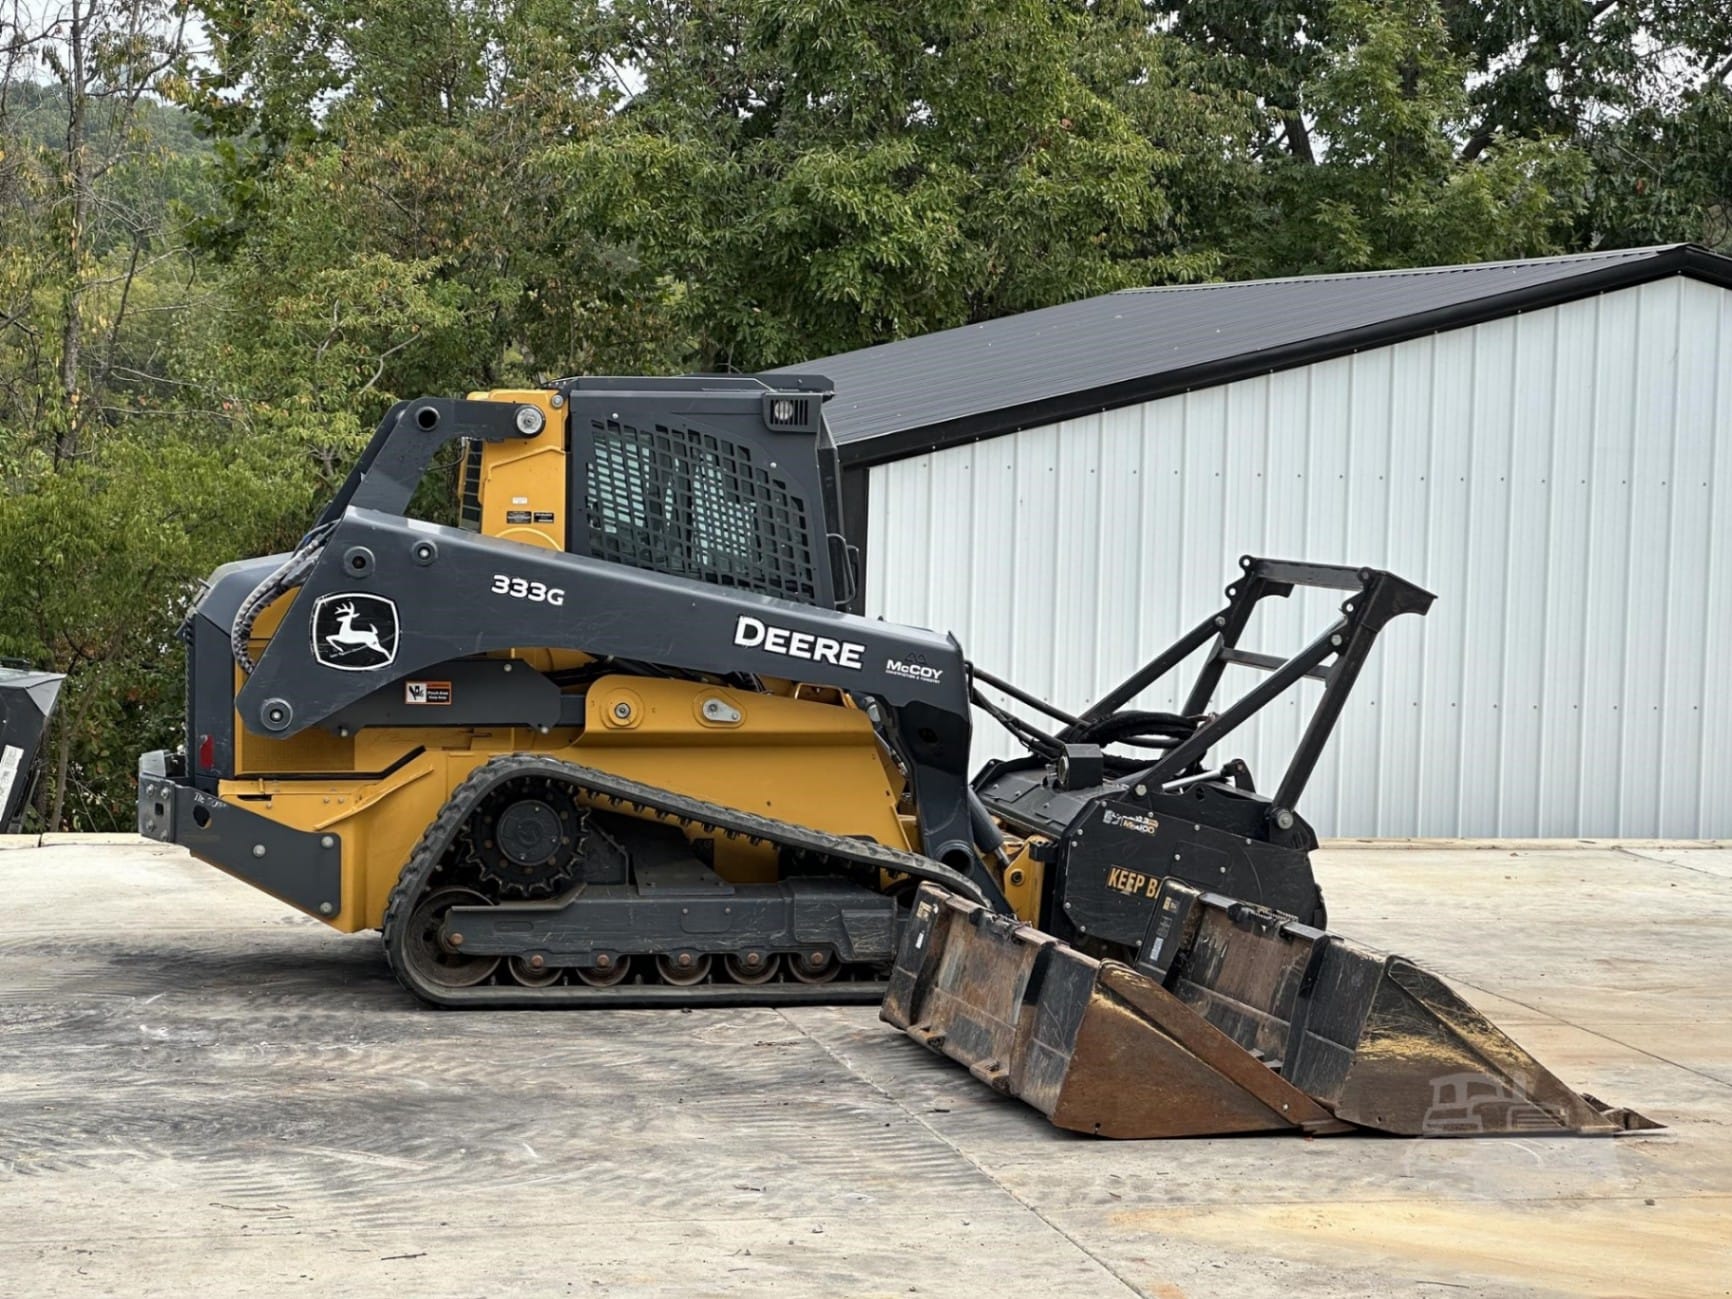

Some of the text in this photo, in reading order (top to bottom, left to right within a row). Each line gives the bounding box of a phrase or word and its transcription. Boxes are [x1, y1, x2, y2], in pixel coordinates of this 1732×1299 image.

[491, 574, 565, 606] 333G
[734, 615, 866, 669] DEERE
[886, 659, 943, 680] McCOY
[1108, 867, 1145, 894] KEEP
